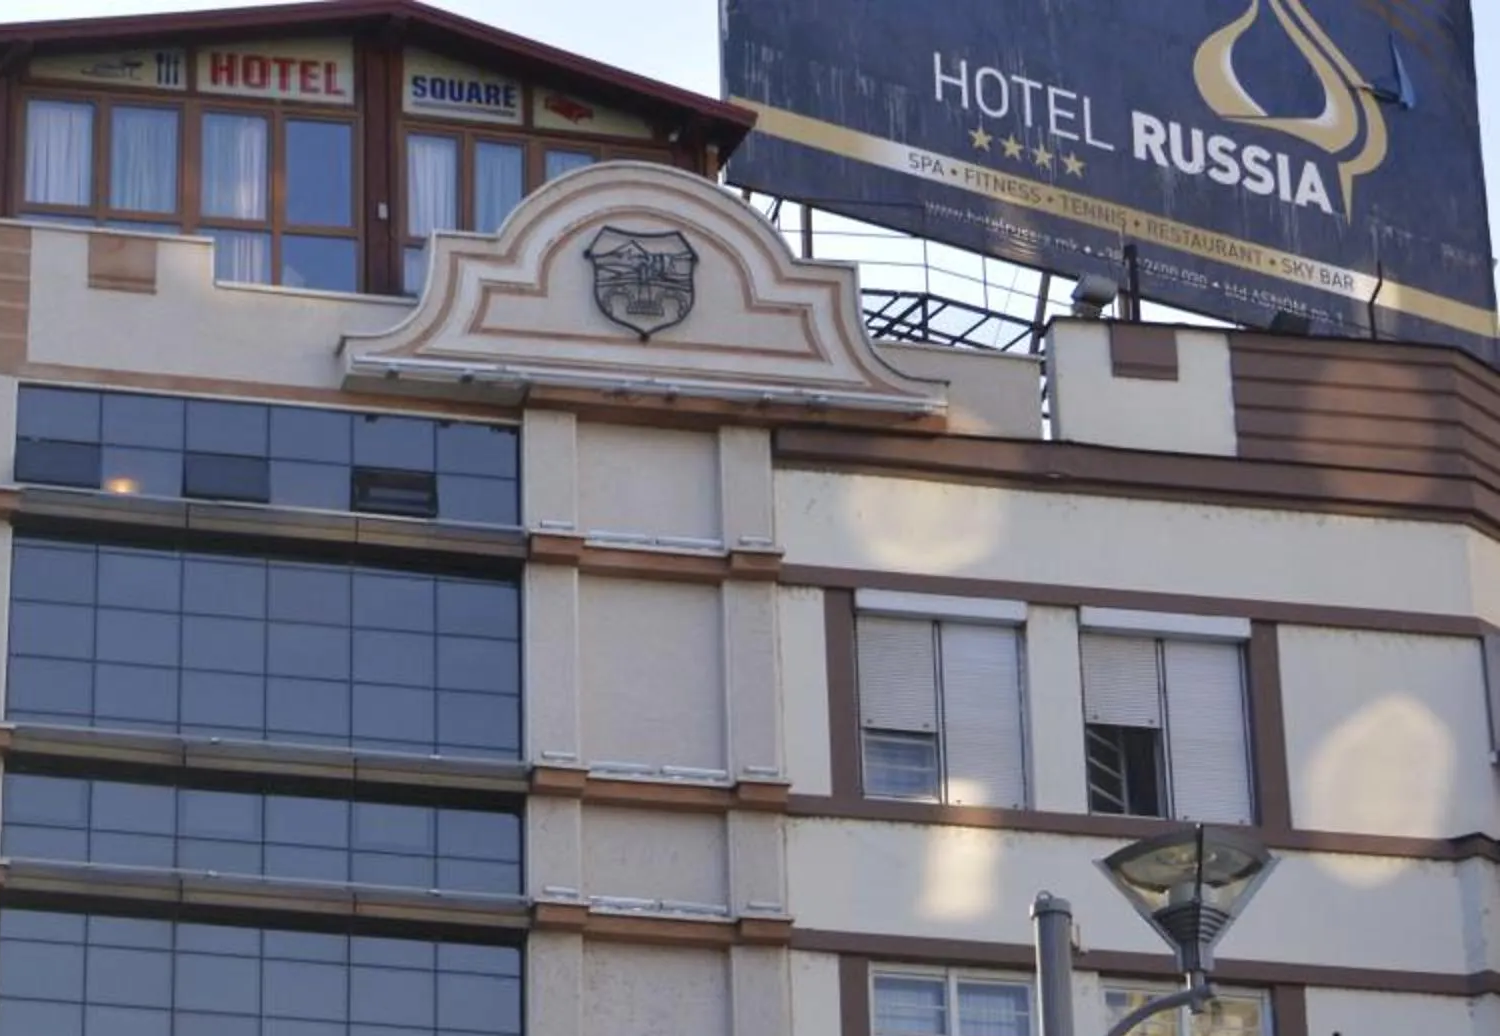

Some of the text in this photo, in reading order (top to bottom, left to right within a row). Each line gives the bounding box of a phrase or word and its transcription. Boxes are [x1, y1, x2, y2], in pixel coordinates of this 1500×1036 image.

[209, 52, 345, 96] HOTEL
[411, 74, 517, 109] SQUARE
[933, 52, 1333, 214] HOTEL RUSSIA
[908, 152, 1355, 292] SPA FITNESS TENNIS RESTAURANT SKY BAR
